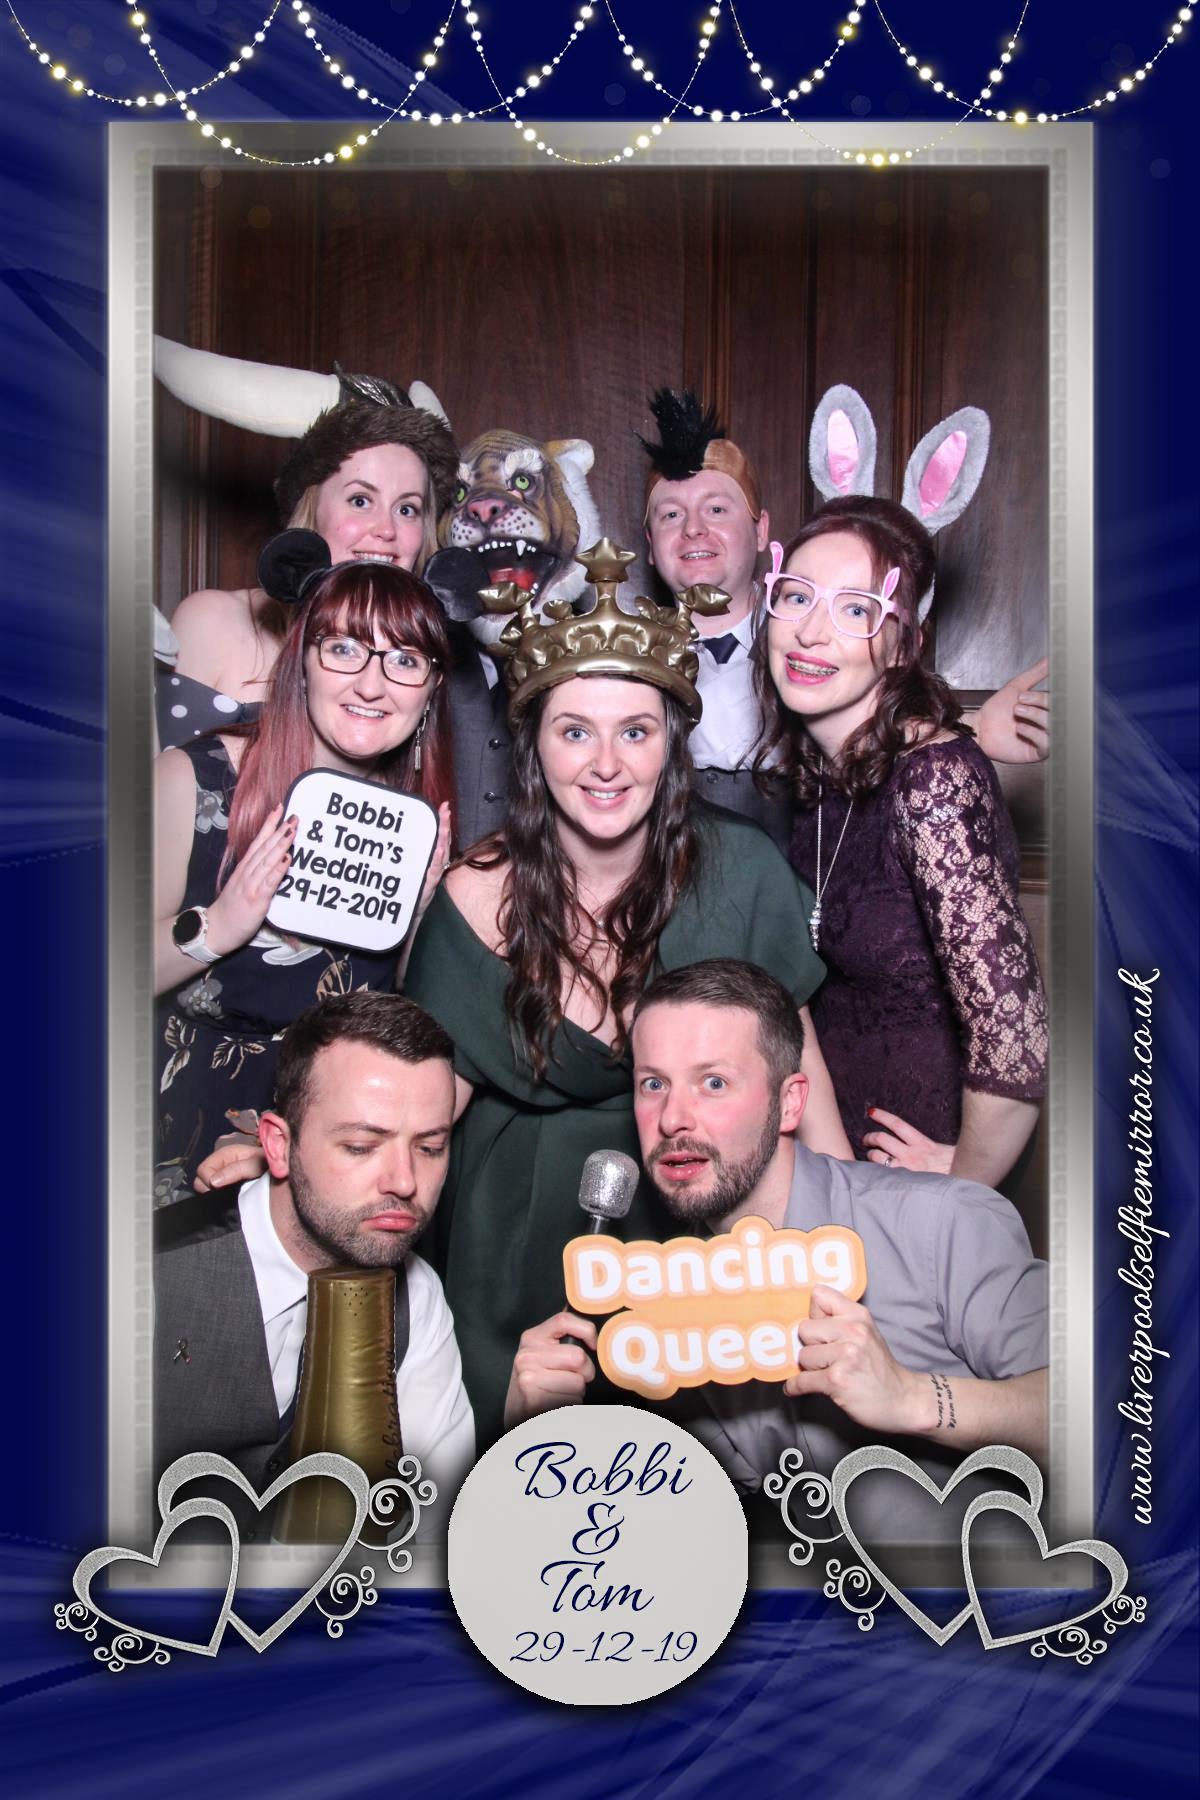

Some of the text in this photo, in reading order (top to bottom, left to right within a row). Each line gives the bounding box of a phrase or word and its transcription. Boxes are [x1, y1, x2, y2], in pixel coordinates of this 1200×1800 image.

[326, 792, 404, 833] Bobbi
[306, 820, 404, 864] & Tom's
[289, 844, 401, 898] Wedding
[275, 873, 402, 925] 29-12-2019
[576, 1229, 853, 1300] Dancing
[610, 1325, 804, 1385] Quee
